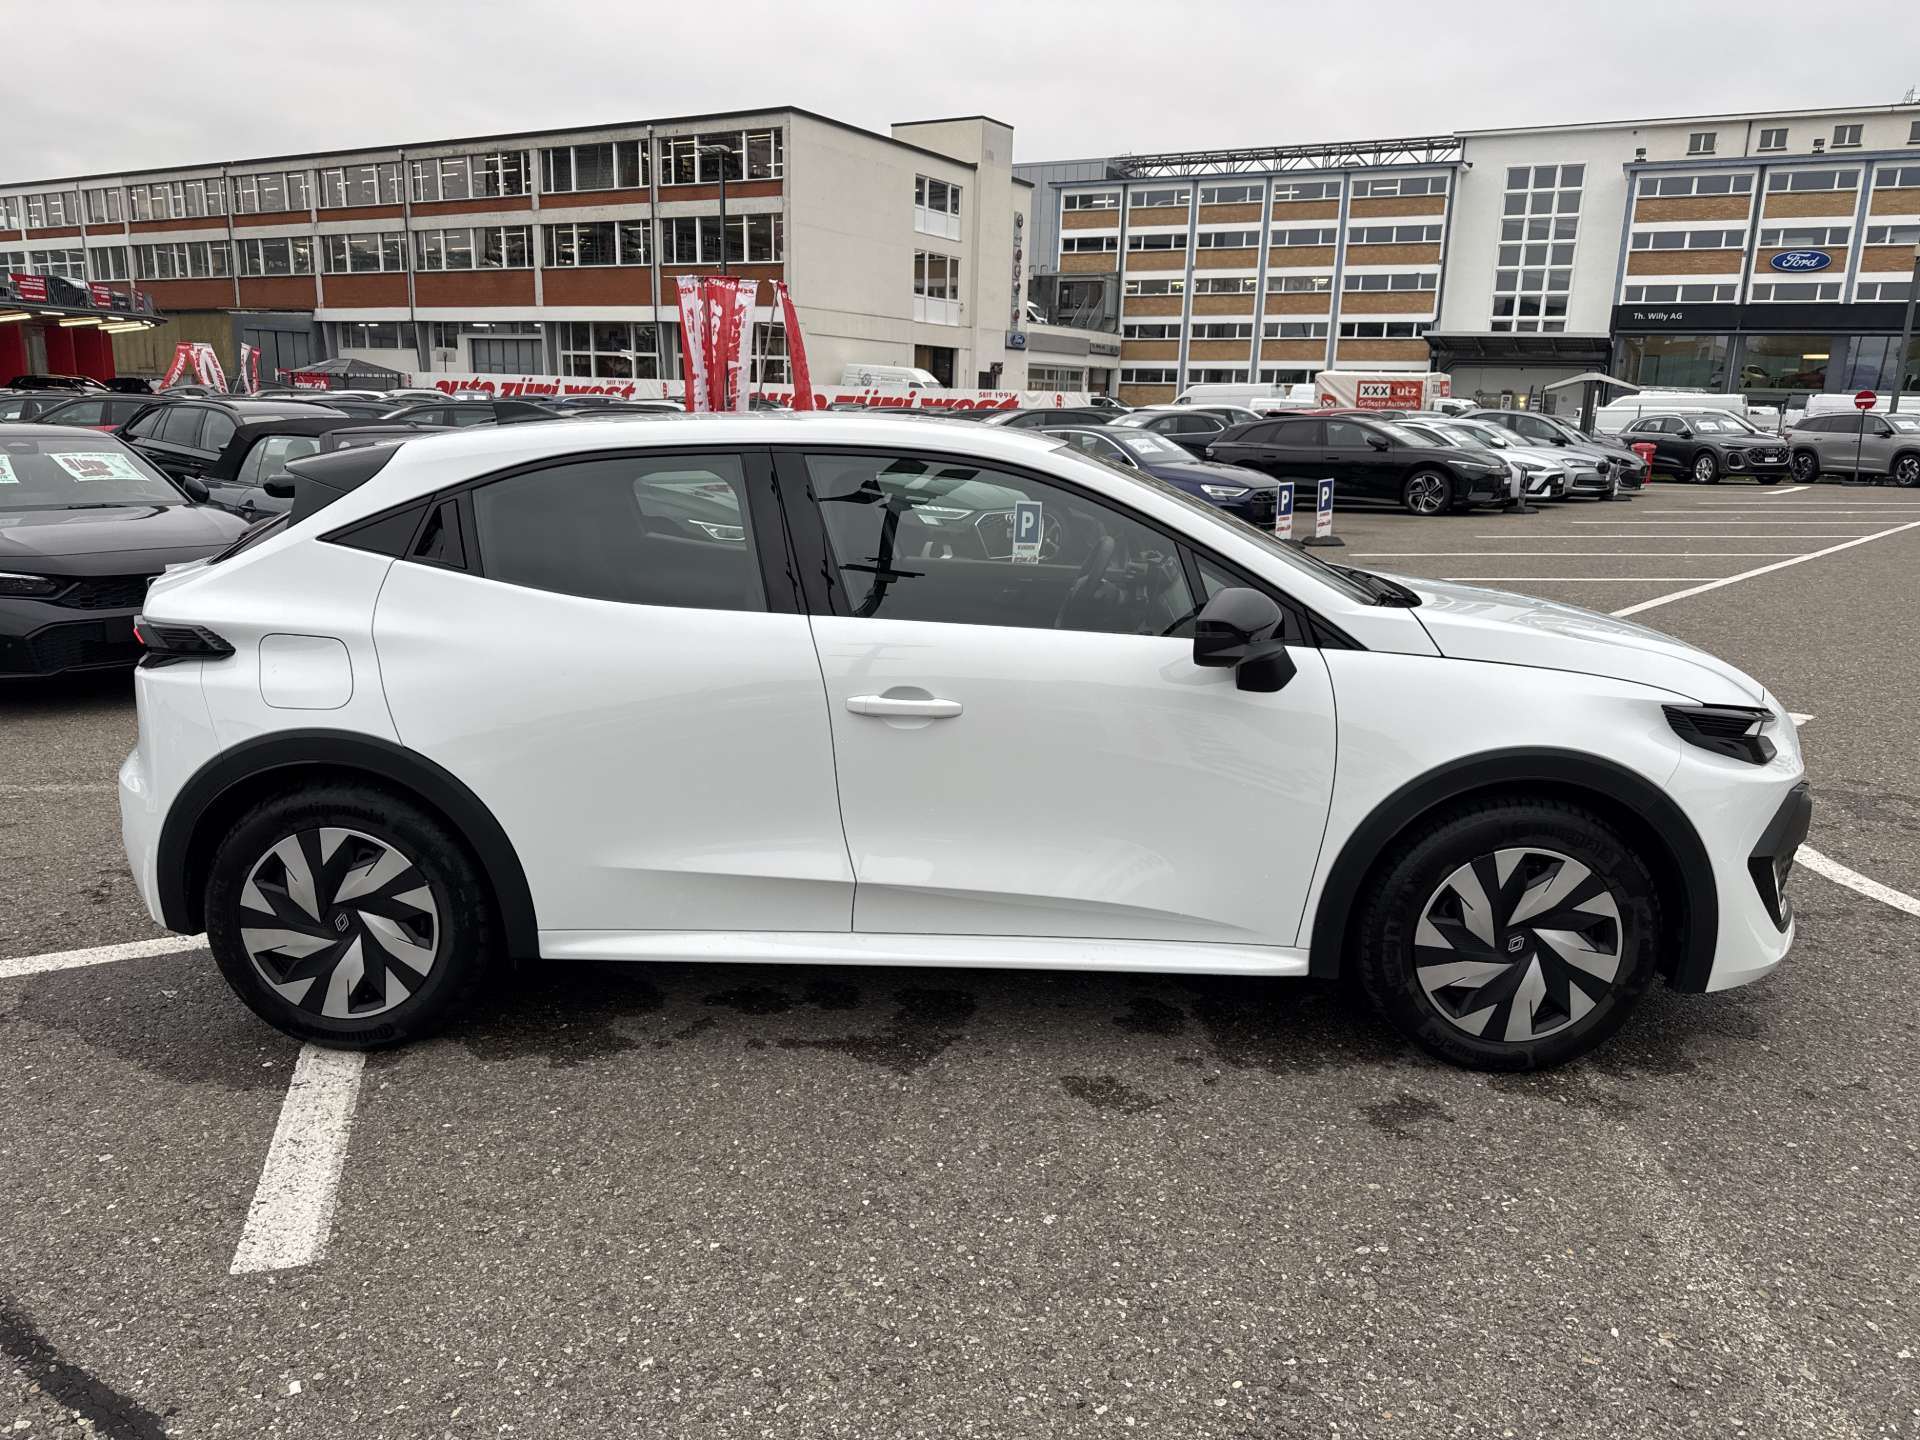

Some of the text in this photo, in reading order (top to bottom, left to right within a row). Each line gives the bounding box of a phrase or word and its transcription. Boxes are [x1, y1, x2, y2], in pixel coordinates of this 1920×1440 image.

[1782, 253, 1819, 267] Ford
[1633, 312, 1683, 322] Th. Willy AG
[978, 391, 1012, 399] SEIT 1991
[1281, 490, 1289, 511] P
[1321, 487, 1329, 507] P
[1021, 511, 1034, 537] P
